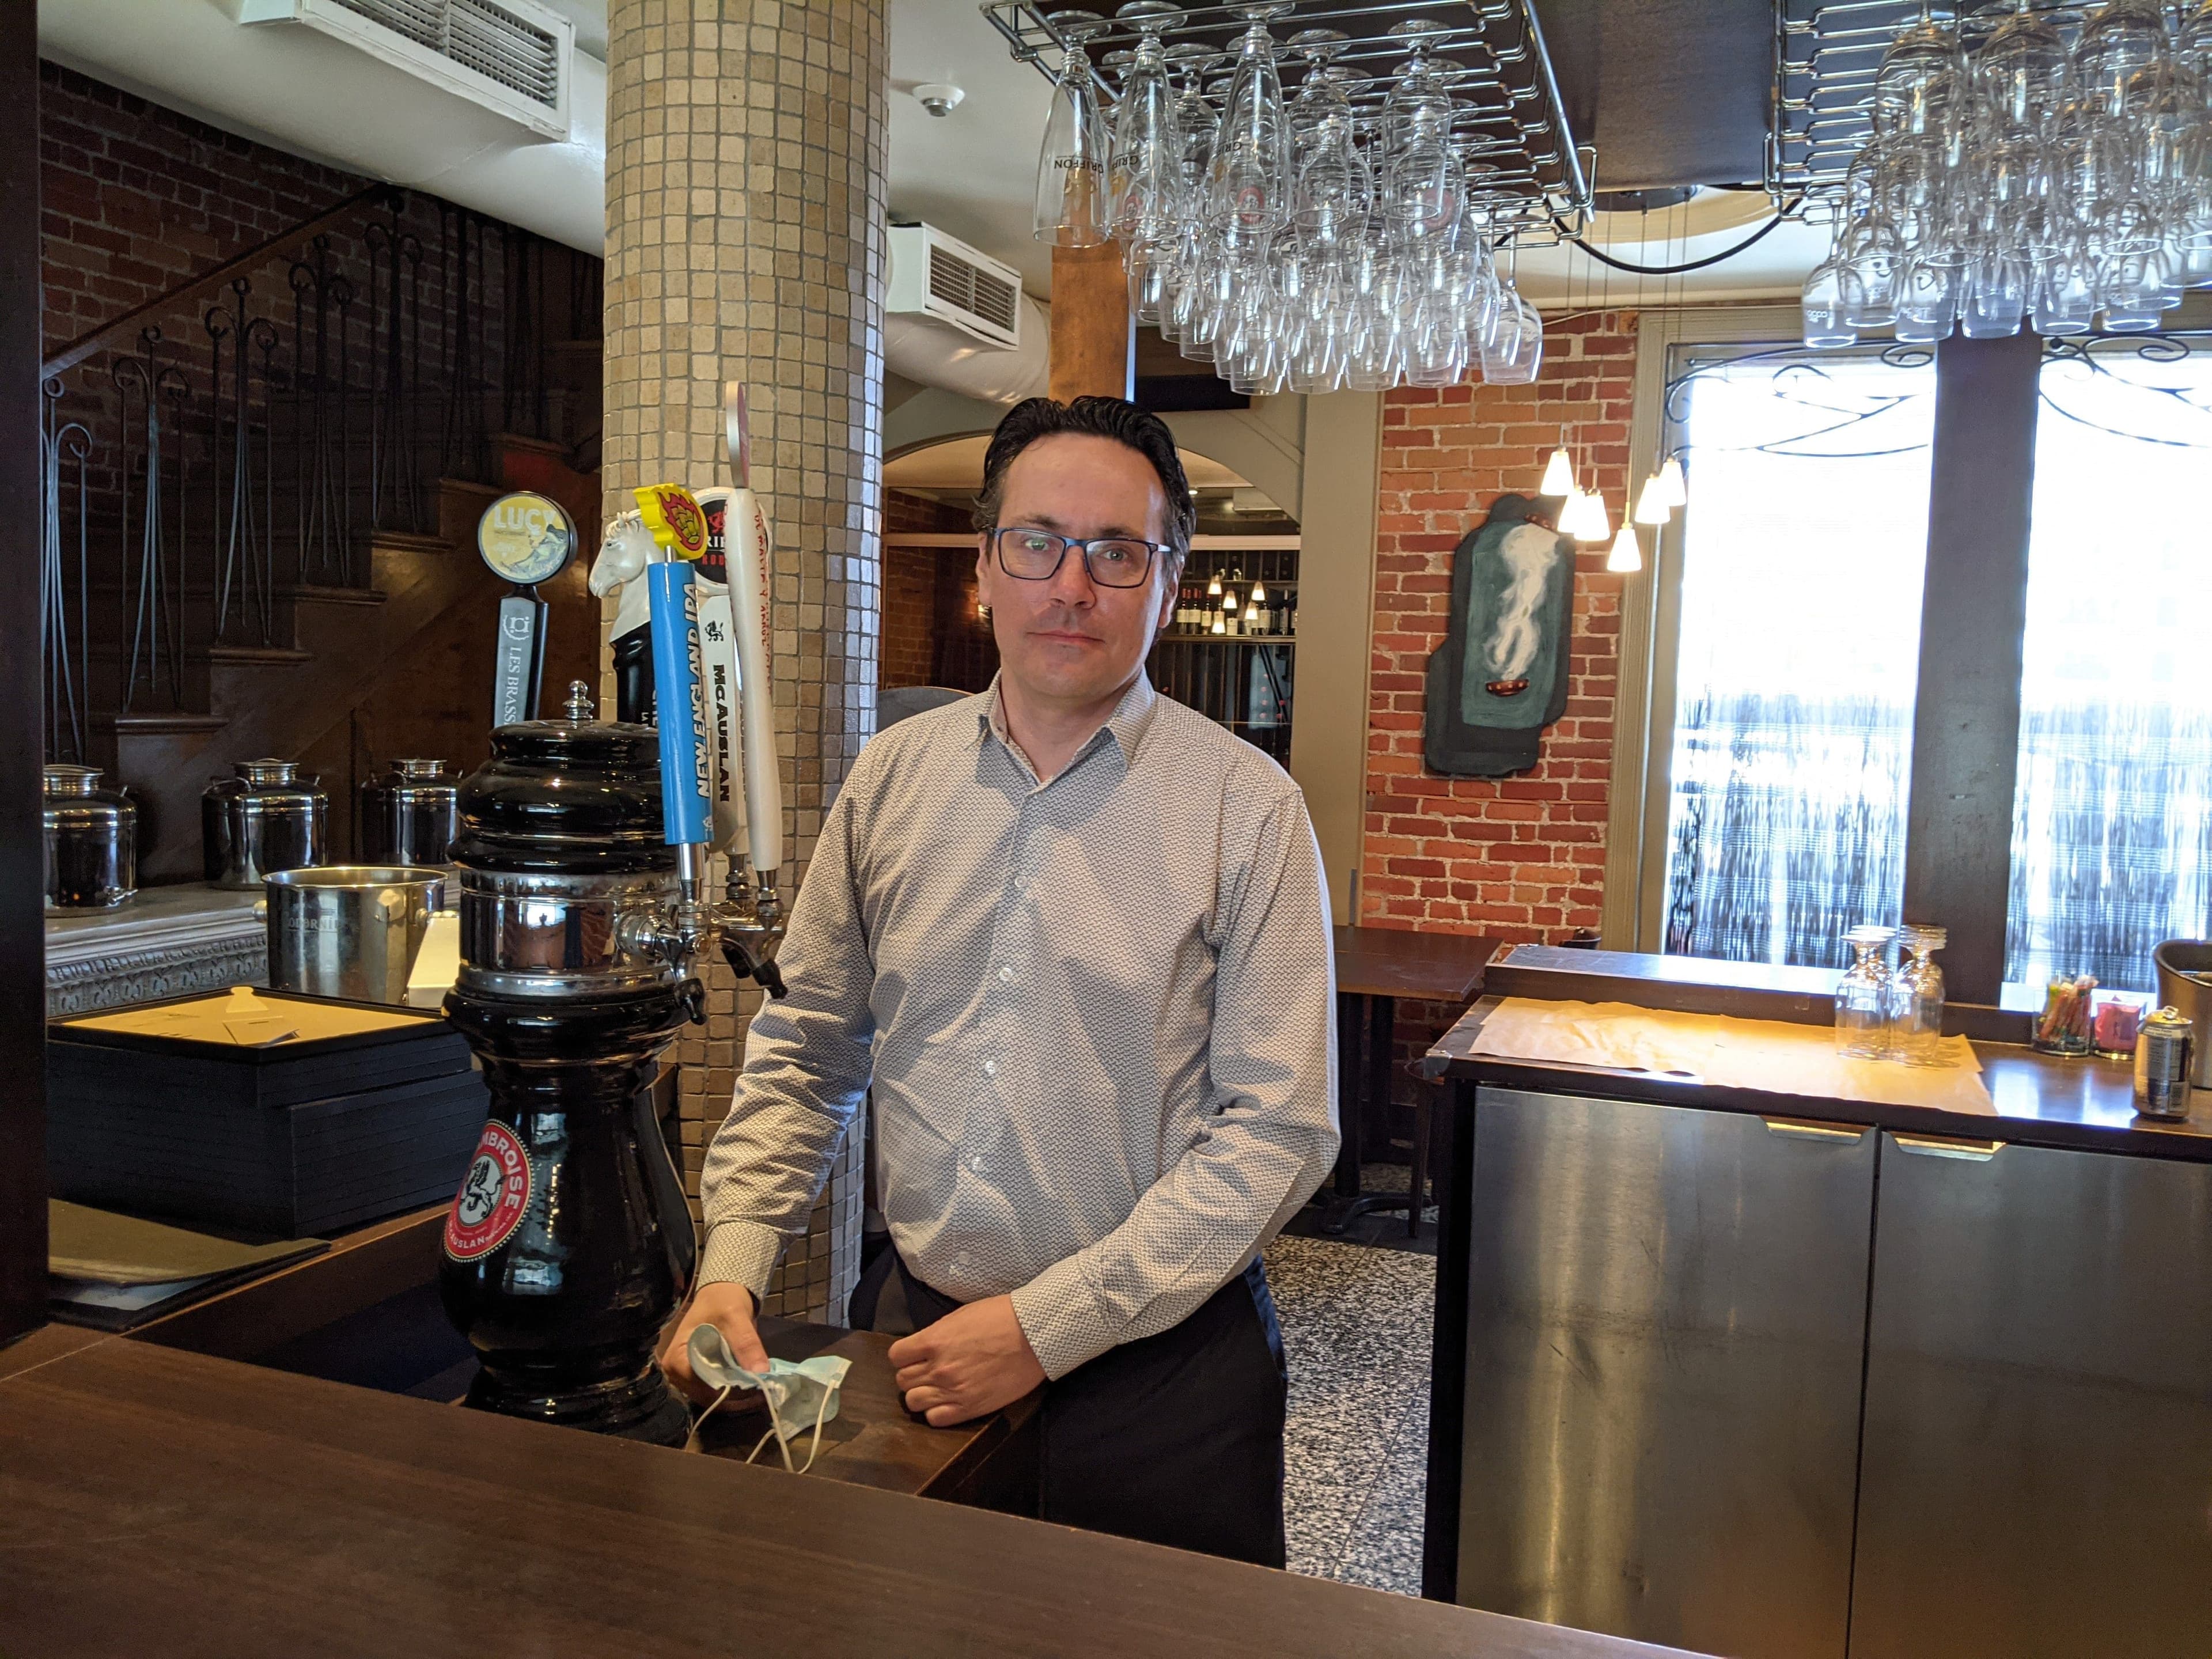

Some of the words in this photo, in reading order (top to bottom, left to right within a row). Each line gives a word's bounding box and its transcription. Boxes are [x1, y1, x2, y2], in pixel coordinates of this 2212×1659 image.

[1054, 159, 1104, 174] GRIFFON
[494, 506, 557, 535] LUCY
[683, 583, 698, 623] IPA
[509, 646, 522, 673] LES
[503, 677, 520, 724] BRASS
[687, 627, 706, 738] ENGLAND
[695, 741, 710, 798] NEW
[479, 1131, 522, 1209] MBROISE
